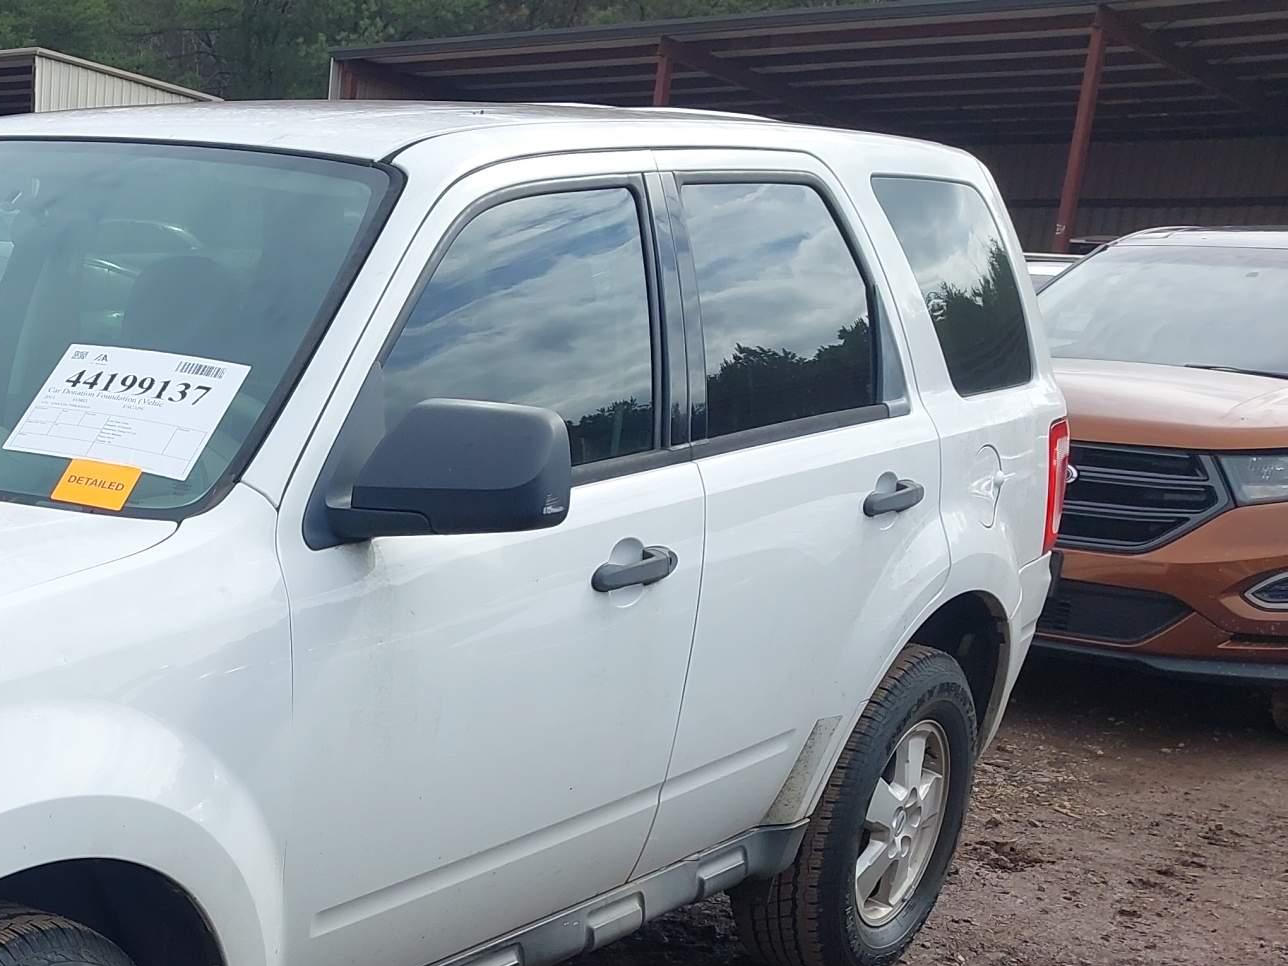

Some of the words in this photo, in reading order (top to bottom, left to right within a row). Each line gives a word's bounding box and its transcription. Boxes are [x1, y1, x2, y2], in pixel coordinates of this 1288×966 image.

[62, 388, 95, 398] Donation
[95, 391, 137, 404] Foundation
[66, 370, 213, 405] 44199137
[67, 474, 125, 492] DETAILED
